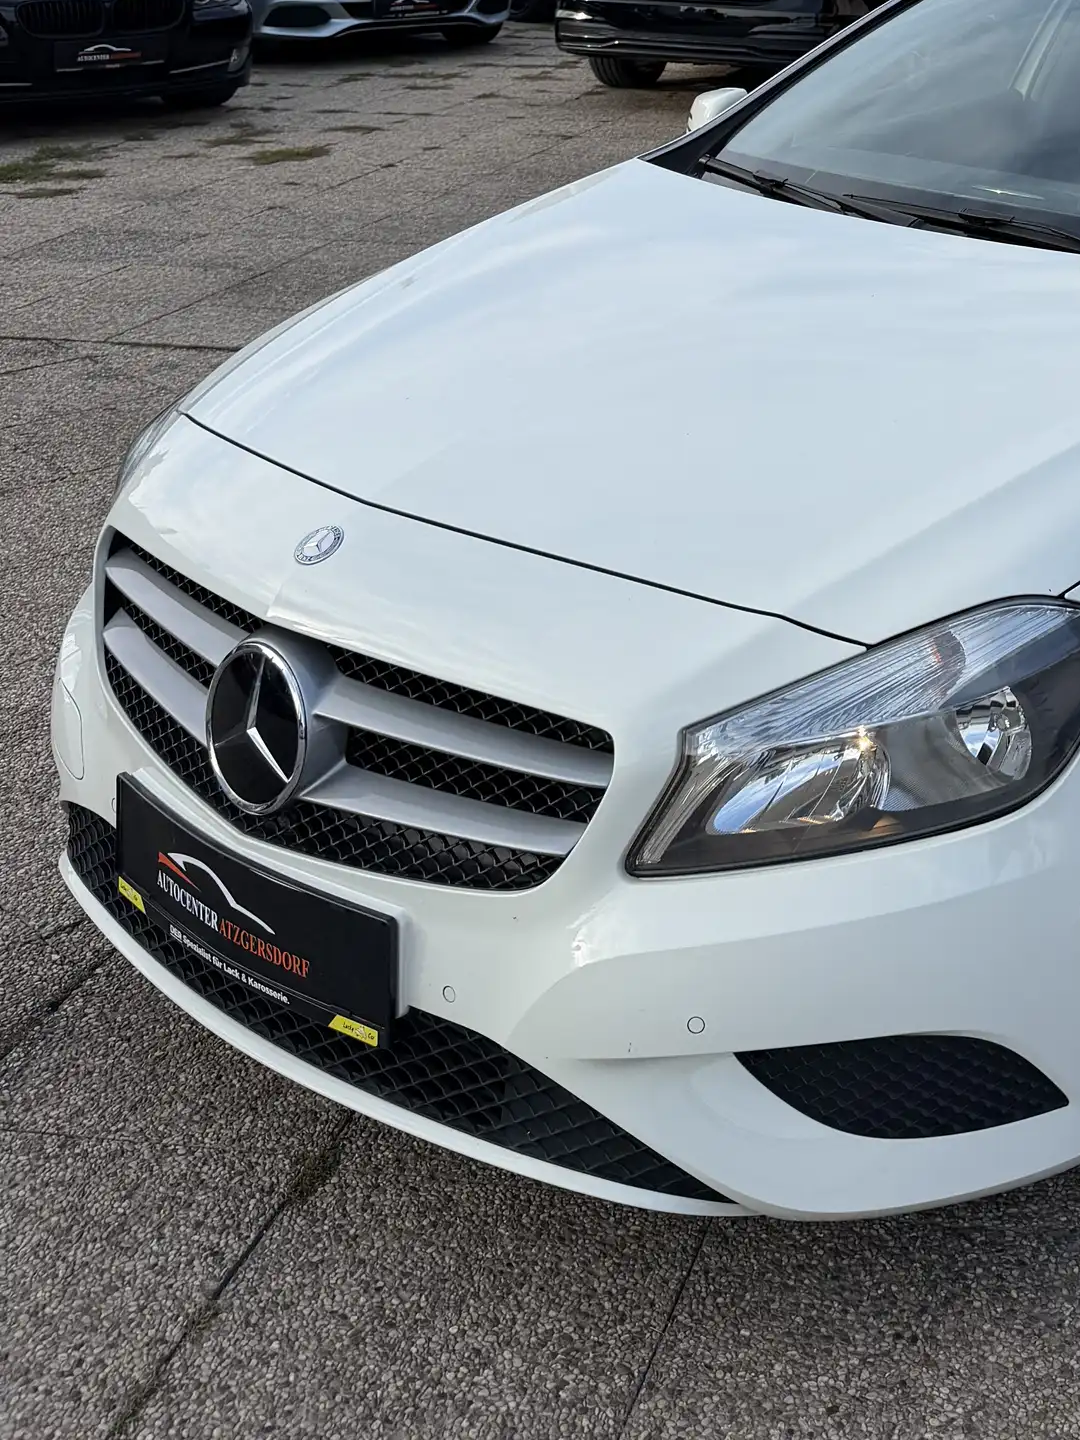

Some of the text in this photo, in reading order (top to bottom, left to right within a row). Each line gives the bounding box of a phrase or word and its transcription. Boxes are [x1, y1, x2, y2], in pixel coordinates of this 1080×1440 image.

[157, 870, 310, 978] AUTOCENTER ATZGERSDORF
[169, 924, 290, 1005] DER Spezialist für Lack & Karosserie.
